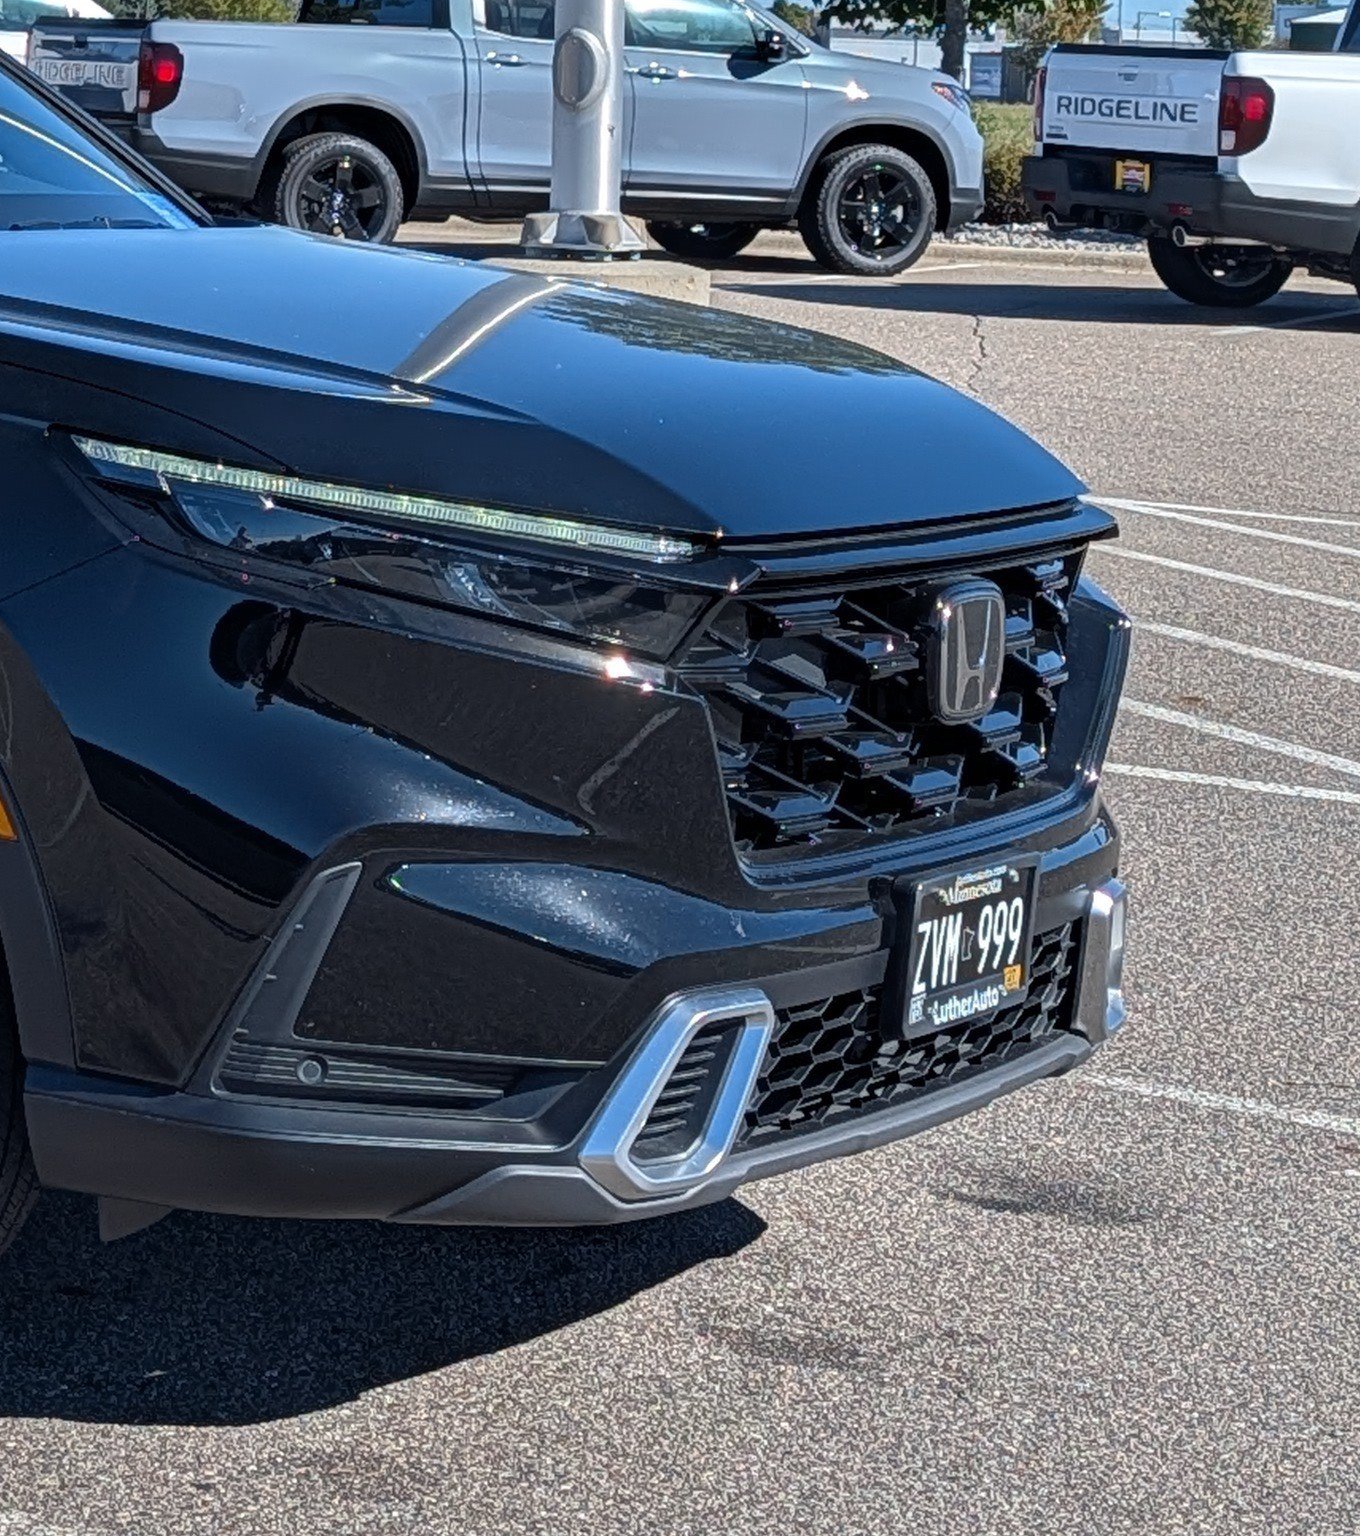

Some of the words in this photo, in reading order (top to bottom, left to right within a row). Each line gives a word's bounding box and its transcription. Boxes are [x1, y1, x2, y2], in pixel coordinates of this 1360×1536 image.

[1056, 95, 1199, 124] RIDGELINE
[912, 912, 963, 995] ZVM
[977, 897, 1024, 974] 999
[933, 985, 1000, 1026] LutherAuto
